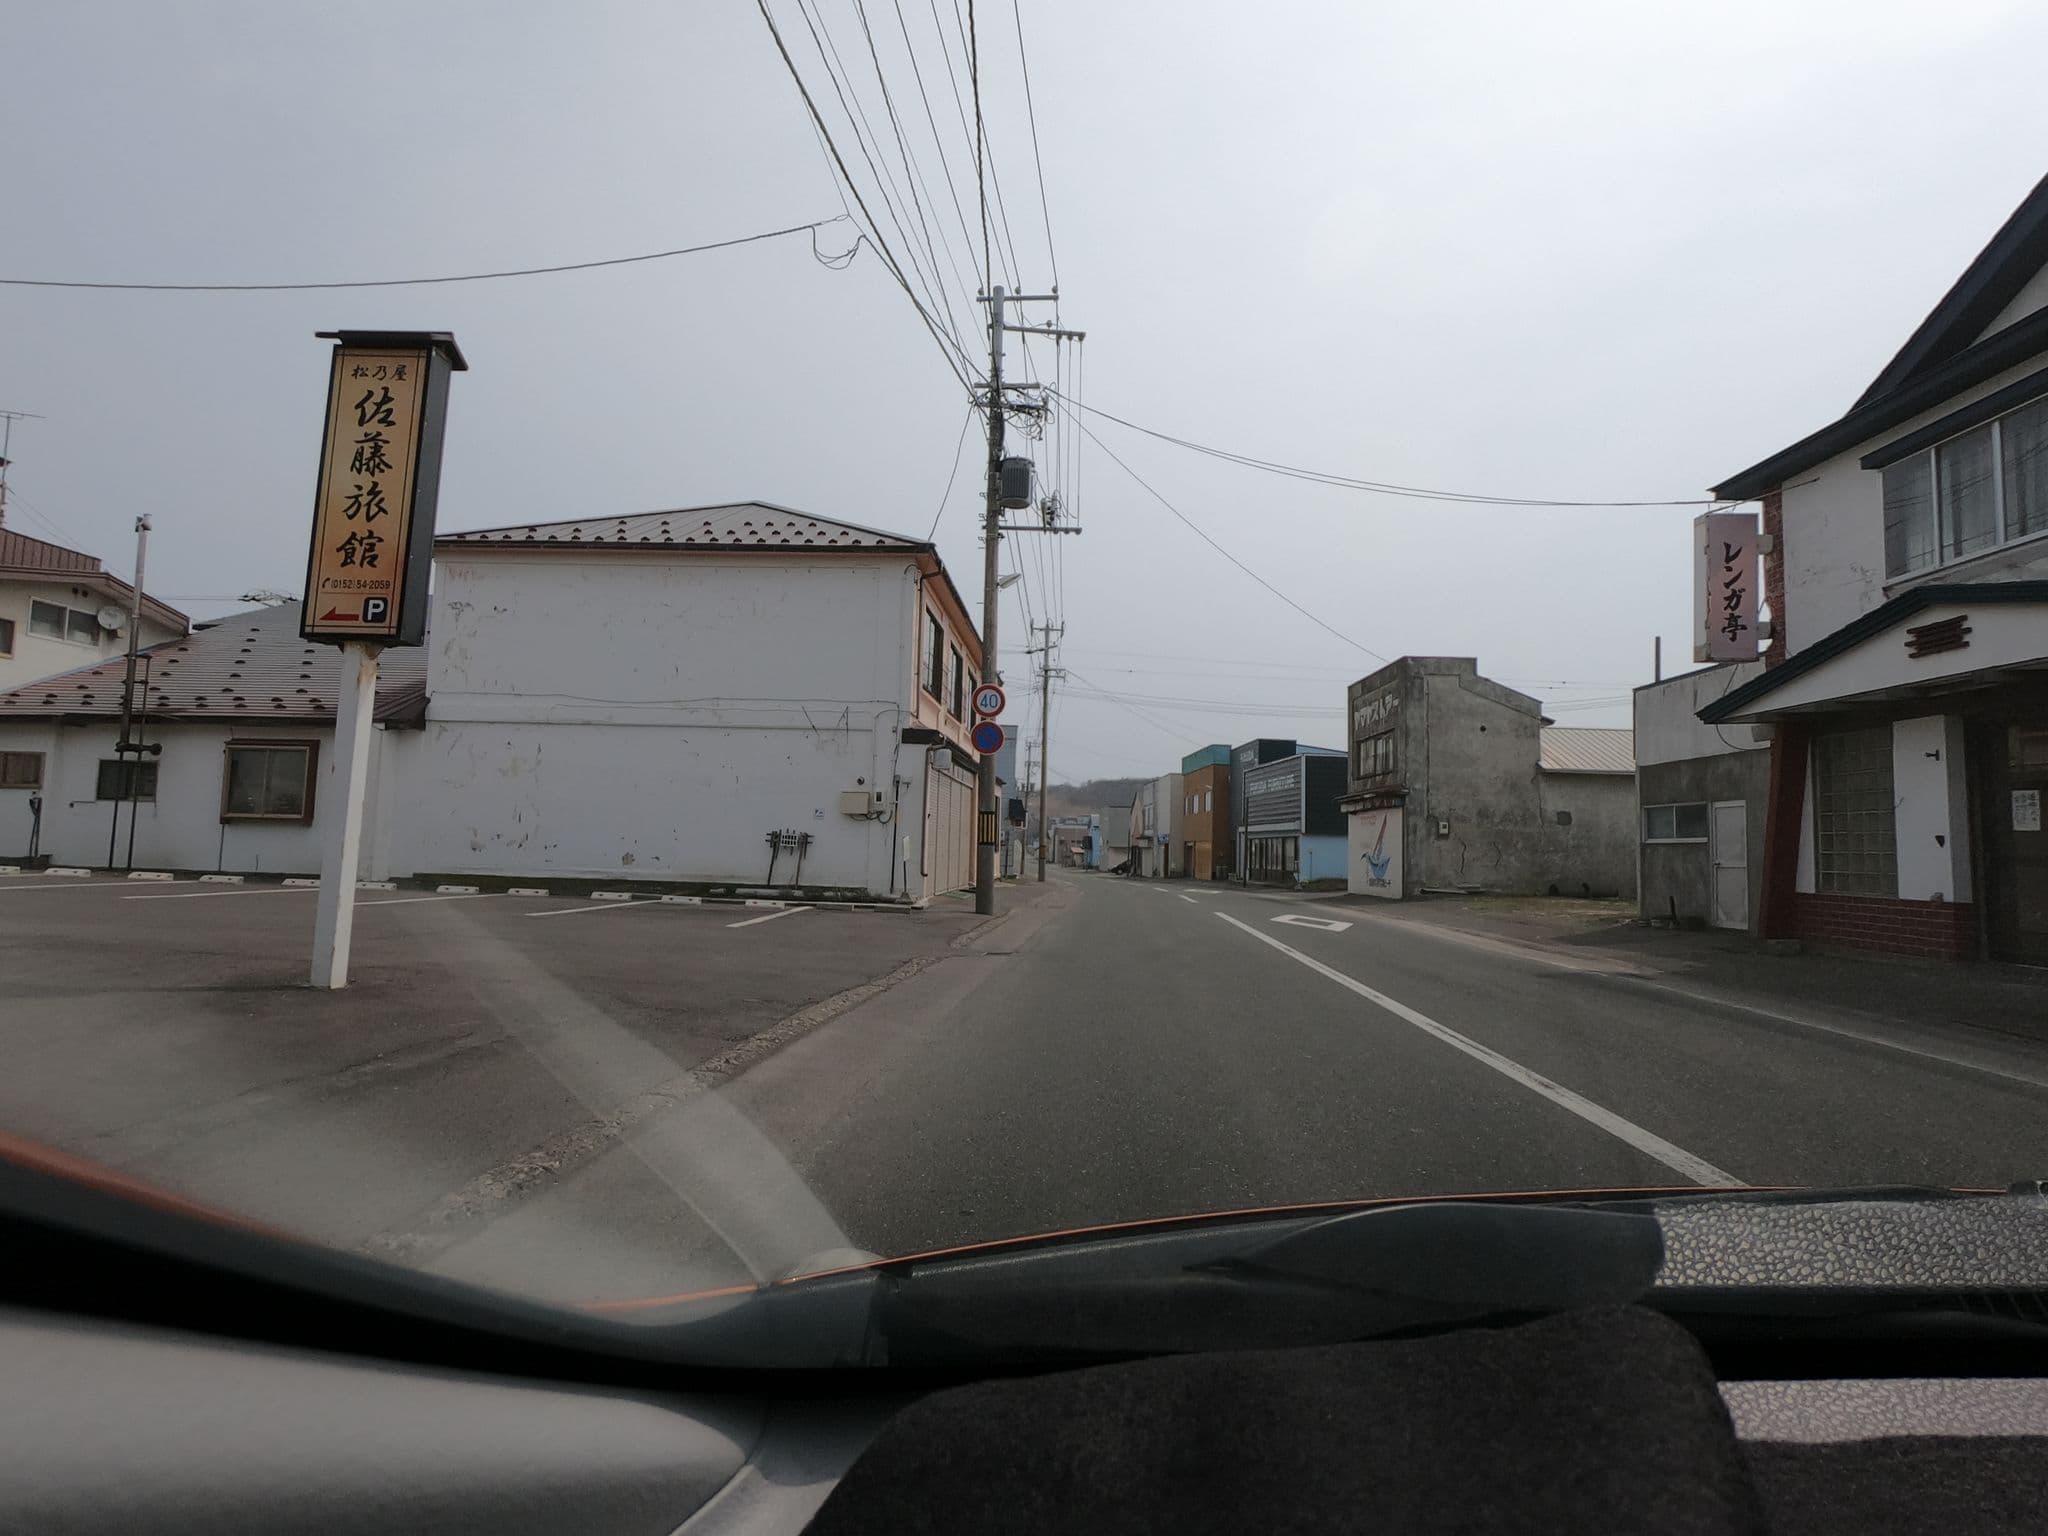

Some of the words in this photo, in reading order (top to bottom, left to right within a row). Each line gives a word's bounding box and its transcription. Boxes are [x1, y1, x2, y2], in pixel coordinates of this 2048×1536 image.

[336, 386, 397, 569] 佐藤旅館
[367, 599, 385, 621] P
[1721, 541, 1748, 642] レンガ亭
[980, 694, 998, 708] 40
